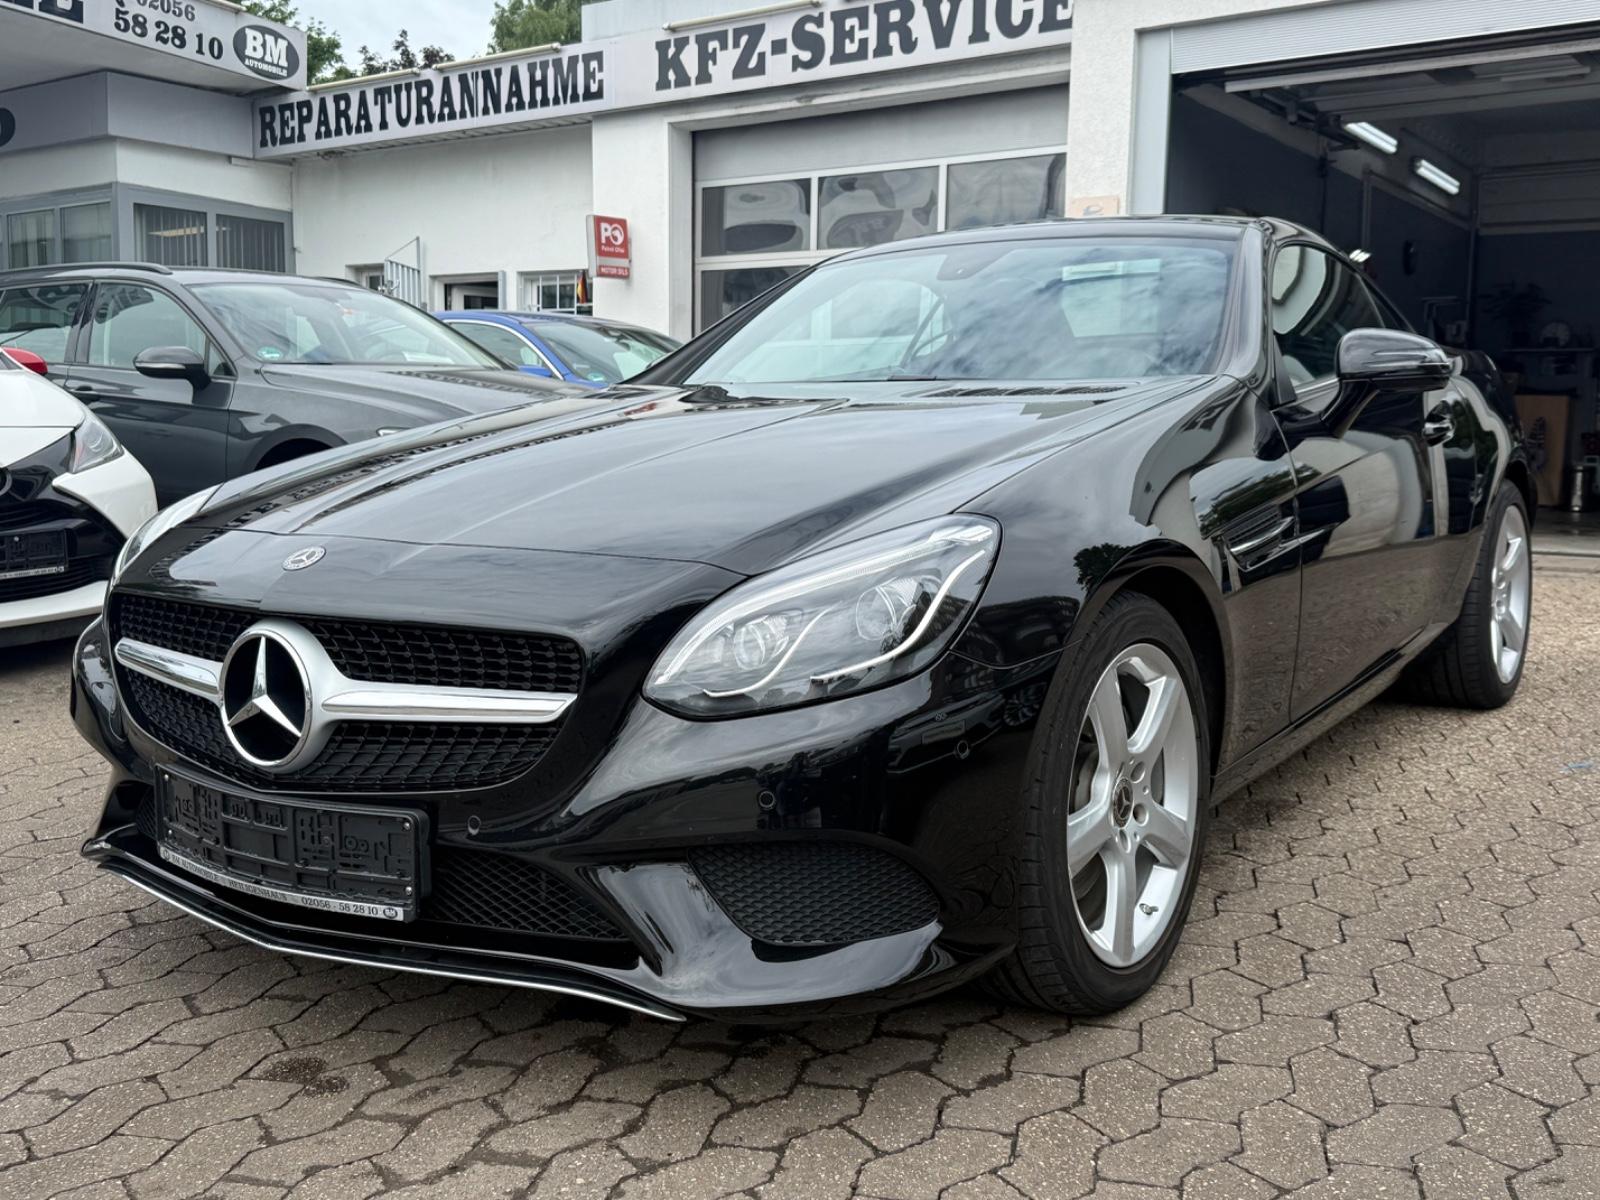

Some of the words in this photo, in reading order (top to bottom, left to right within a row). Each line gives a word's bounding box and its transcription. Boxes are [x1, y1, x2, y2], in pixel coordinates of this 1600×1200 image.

[114, 8, 148, 38] 58
[155, 20, 187, 49] 28
[195, 33, 224, 60] 10
[244, 27, 288, 68] BM
[655, 0, 1072, 92] KFZ-SERVICE
[244, 58, 288, 77] AUTOMOBILE
[259, 50, 604, 149] REPARATURANNAHME
[301, 896, 331, 909] 02056
[338, 902, 351, 912] 58
[353, 904, 366, 914] 28
[367, 905, 378, 916] 10
